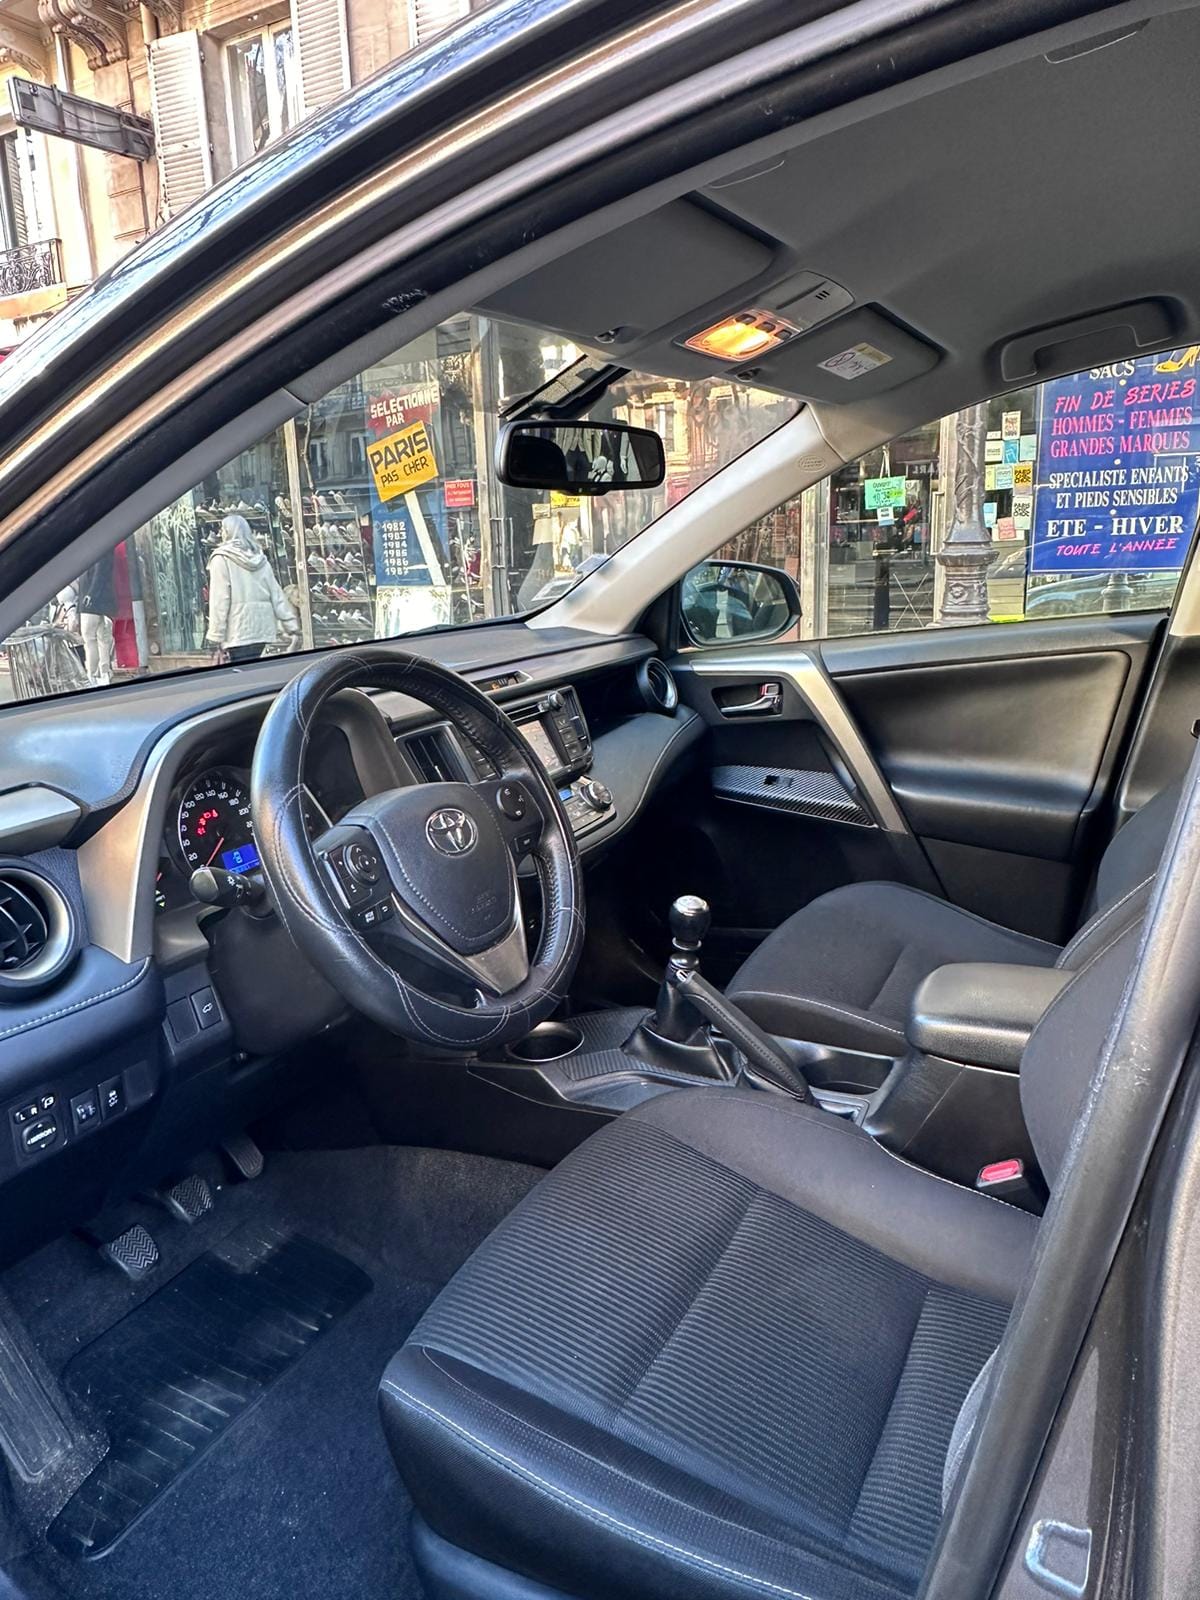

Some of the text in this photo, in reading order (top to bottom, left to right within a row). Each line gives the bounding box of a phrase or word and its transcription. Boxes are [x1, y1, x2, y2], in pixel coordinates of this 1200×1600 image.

[1055, 378, 1197, 414] FIN DE SERIES
[385, 412, 405, 427] PAR
[1051, 414, 1114, 436] HOMMES
[1129, 407, 1193, 430] FEMMES
[370, 429, 428, 475] PARIS
[1051, 431, 1190, 458] GRANDES MARQUES
[381, 456, 429, 488] PAS CHER
[1049, 466, 1189, 489] SPECIALISTE ENFANTS
[1056, 488, 1178, 509] ET PIEDS SENSIBLES
[382, 521, 406, 532] 1982
[382, 532, 407, 541] 1983
[1046, 519, 1087, 538] ETE
[1110, 515, 1185, 536] HIVER
[383, 540, 407, 549] 1984
[383, 549, 408, 557] 1985
[1056, 537, 1180, 557] TOUTE L'ANNEE
[384, 558, 409, 567] 1986
[30, 1107, 38, 1115] R
